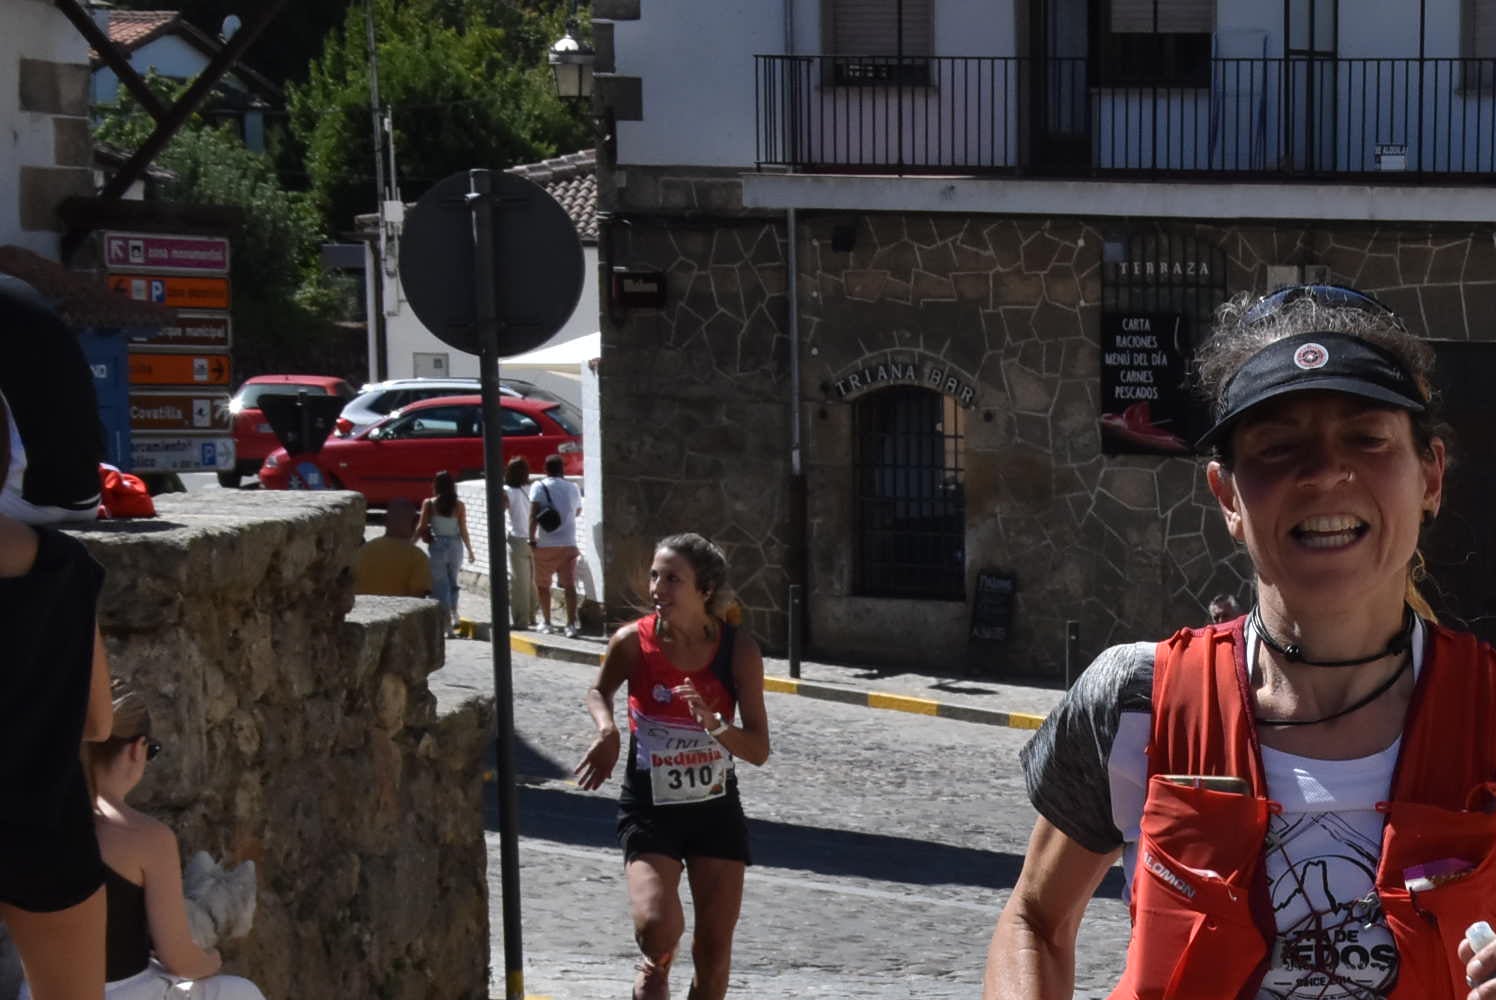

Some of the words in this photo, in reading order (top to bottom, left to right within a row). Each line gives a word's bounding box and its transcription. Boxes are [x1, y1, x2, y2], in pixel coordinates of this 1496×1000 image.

[1120, 262, 1208, 275] TERRAZA
[1122, 318, 1151, 331] CARTA
[1115, 336, 1158, 348] RACIONES
[1105, 350, 1131, 366] MENÚ
[1134, 353, 1149, 366] DEL
[1151, 350, 1168, 366] DÍA
[1120, 370, 1154, 383] CARNES
[835, 364, 915, 396] TRIANA
[929, 369, 974, 403] BAR
[1115, 386, 1158, 399] PESCADOS
[668, 766, 713, 790] 310
